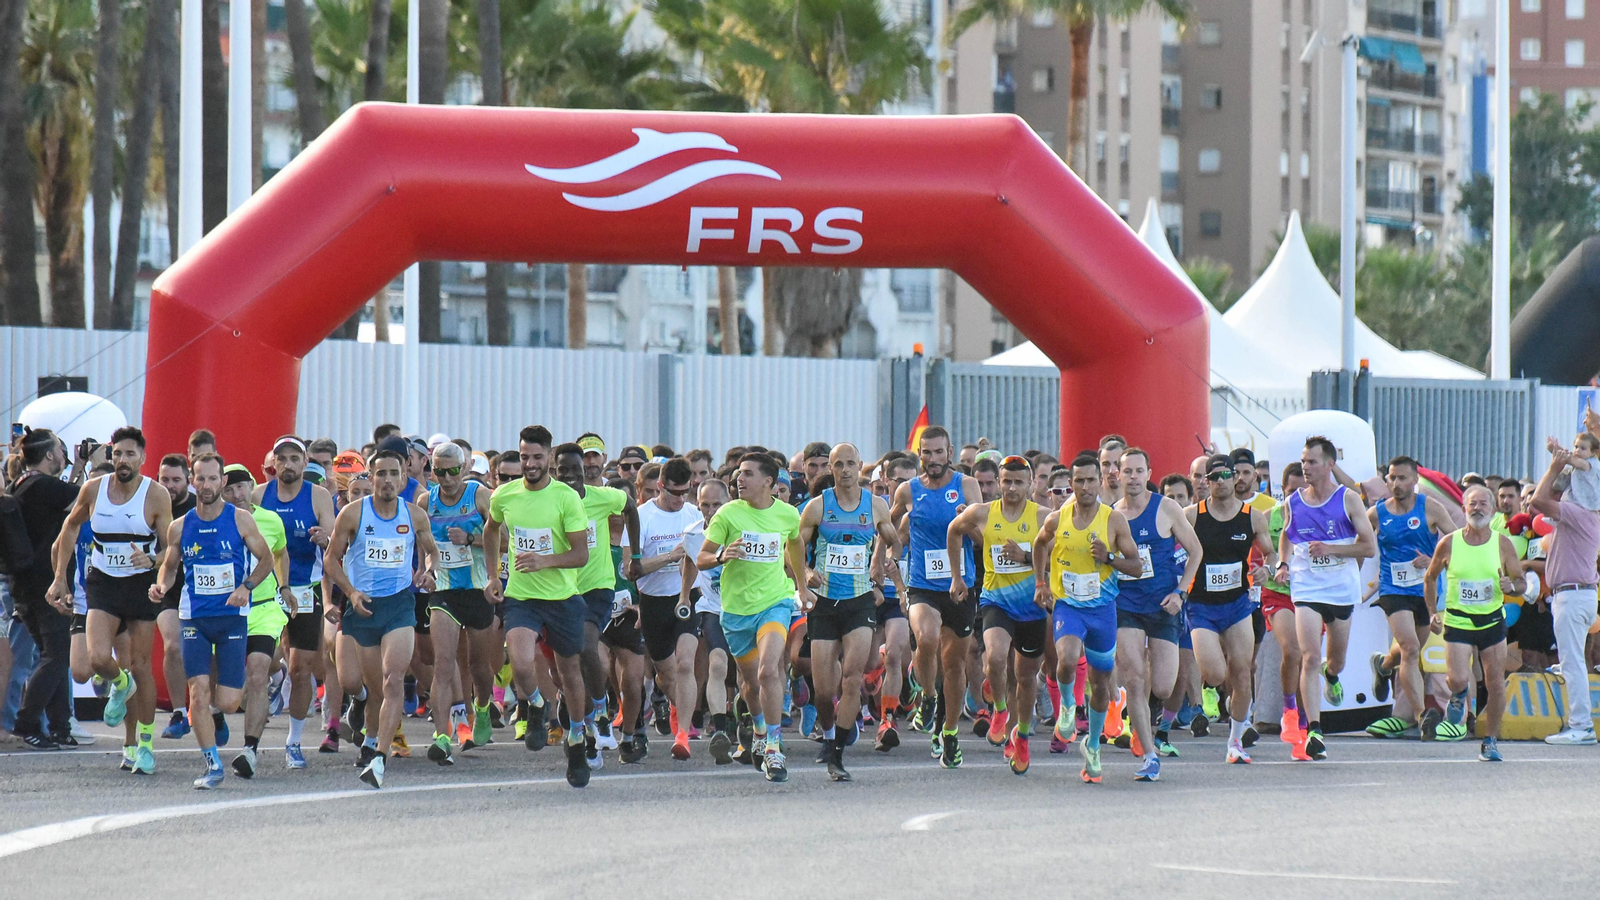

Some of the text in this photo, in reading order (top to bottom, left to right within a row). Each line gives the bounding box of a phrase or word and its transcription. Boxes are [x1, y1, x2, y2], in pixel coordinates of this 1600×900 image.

[686, 206, 864, 254] FRS
[518, 537, 535, 550] 812
[745, 542, 765, 555] 813
[368, 548, 388, 560] 219
[107, 555, 126, 566] 712
[829, 554, 848, 566] 713
[931, 560, 944, 571] 39
[1312, 555, 1330, 565] 436
[197, 575, 216, 587] 338
[1211, 574, 1229, 584] 885
[1397, 571, 1407, 581] 57
[1070, 582, 1075, 593] 1
[1462, 589, 1479, 599] 594
